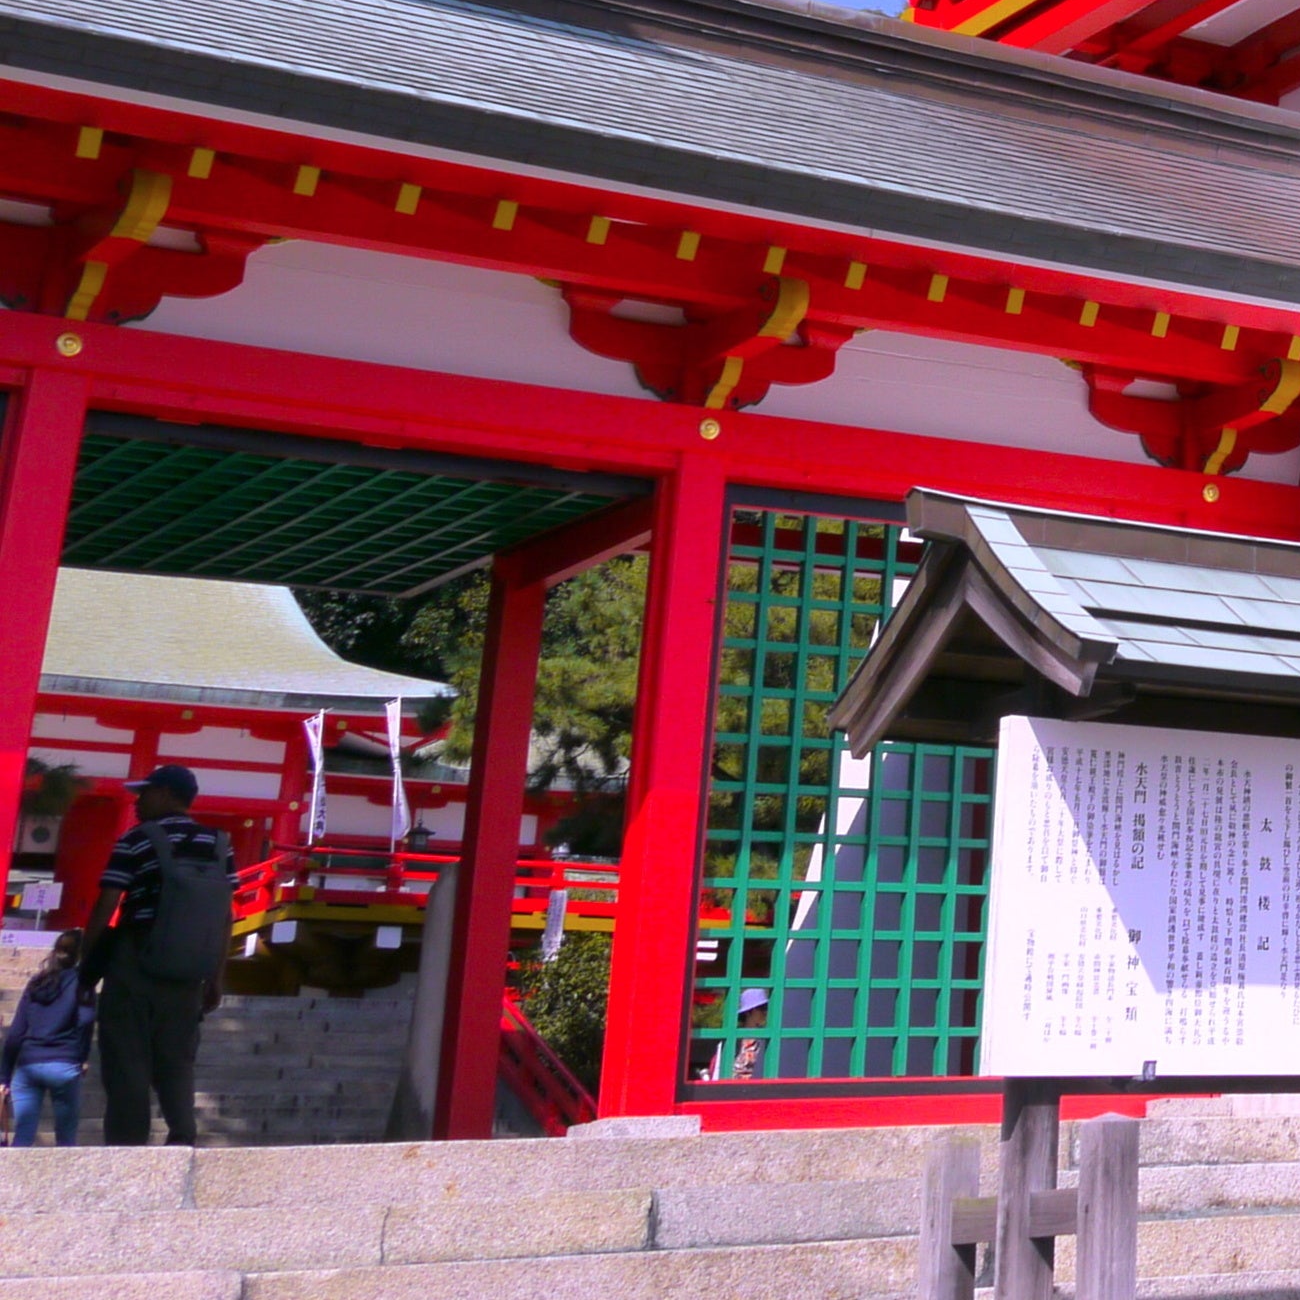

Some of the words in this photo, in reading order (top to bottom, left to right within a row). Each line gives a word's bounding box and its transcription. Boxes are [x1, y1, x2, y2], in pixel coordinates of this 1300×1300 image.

[1134, 762, 1148, 804] 水天門
[1131, 813, 1146, 869] 掲額の記
[1257, 817, 1272, 952] 太鼓楼記
[1125, 929, 1141, 1021] 御神宝類
